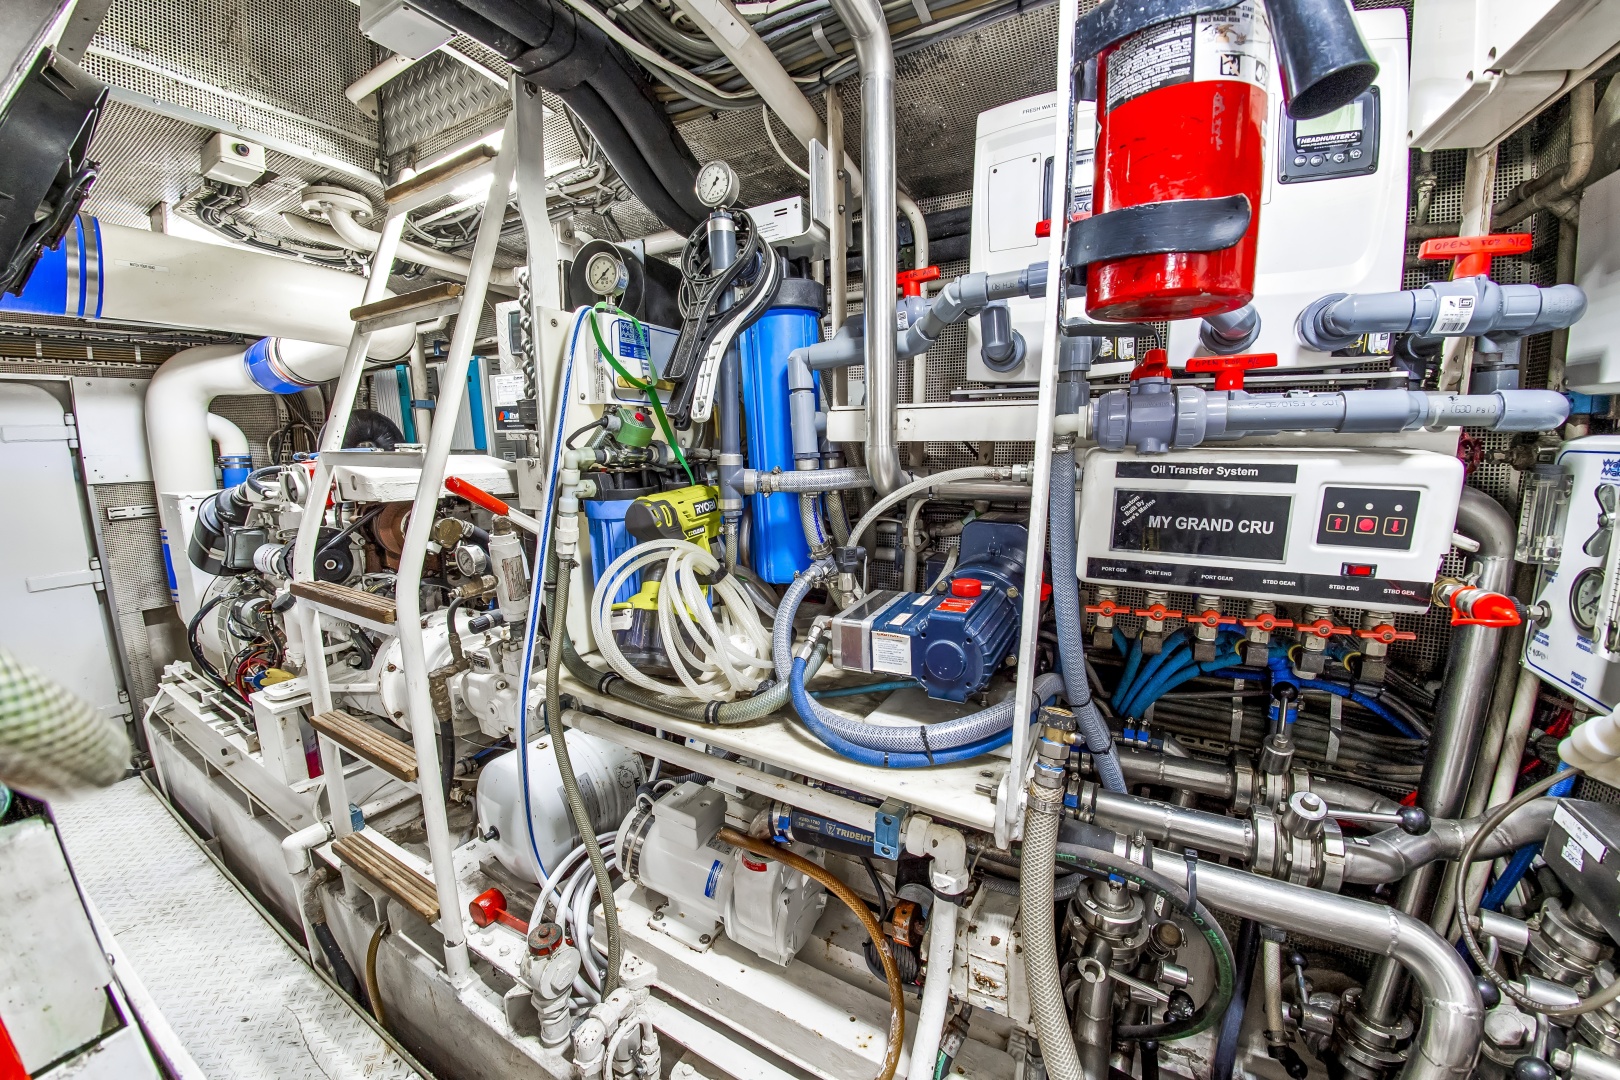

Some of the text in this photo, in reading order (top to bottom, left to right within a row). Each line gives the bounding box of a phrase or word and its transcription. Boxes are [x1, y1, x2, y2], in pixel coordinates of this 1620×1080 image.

[1022, 107, 1040, 115] FRESH
[1301, 132, 1350, 144] HEADHUNTER
[1434, 240, 1470, 250] OPEN
[1508, 237, 1527, 247] A/C
[1151, 465, 1259, 477] Oil Transfer System
[695, 500, 716, 514] RYOBI
[1120, 495, 1140, 511] Custom
[1122, 499, 1156, 526] Dave's Marine
[1124, 505, 1138, 517] Built
[1148, 516, 1275, 535] MY GRAND CRU
[1571, 671, 1587, 683] PRODUCT
[1570, 678, 1585, 690] SAMPLE
